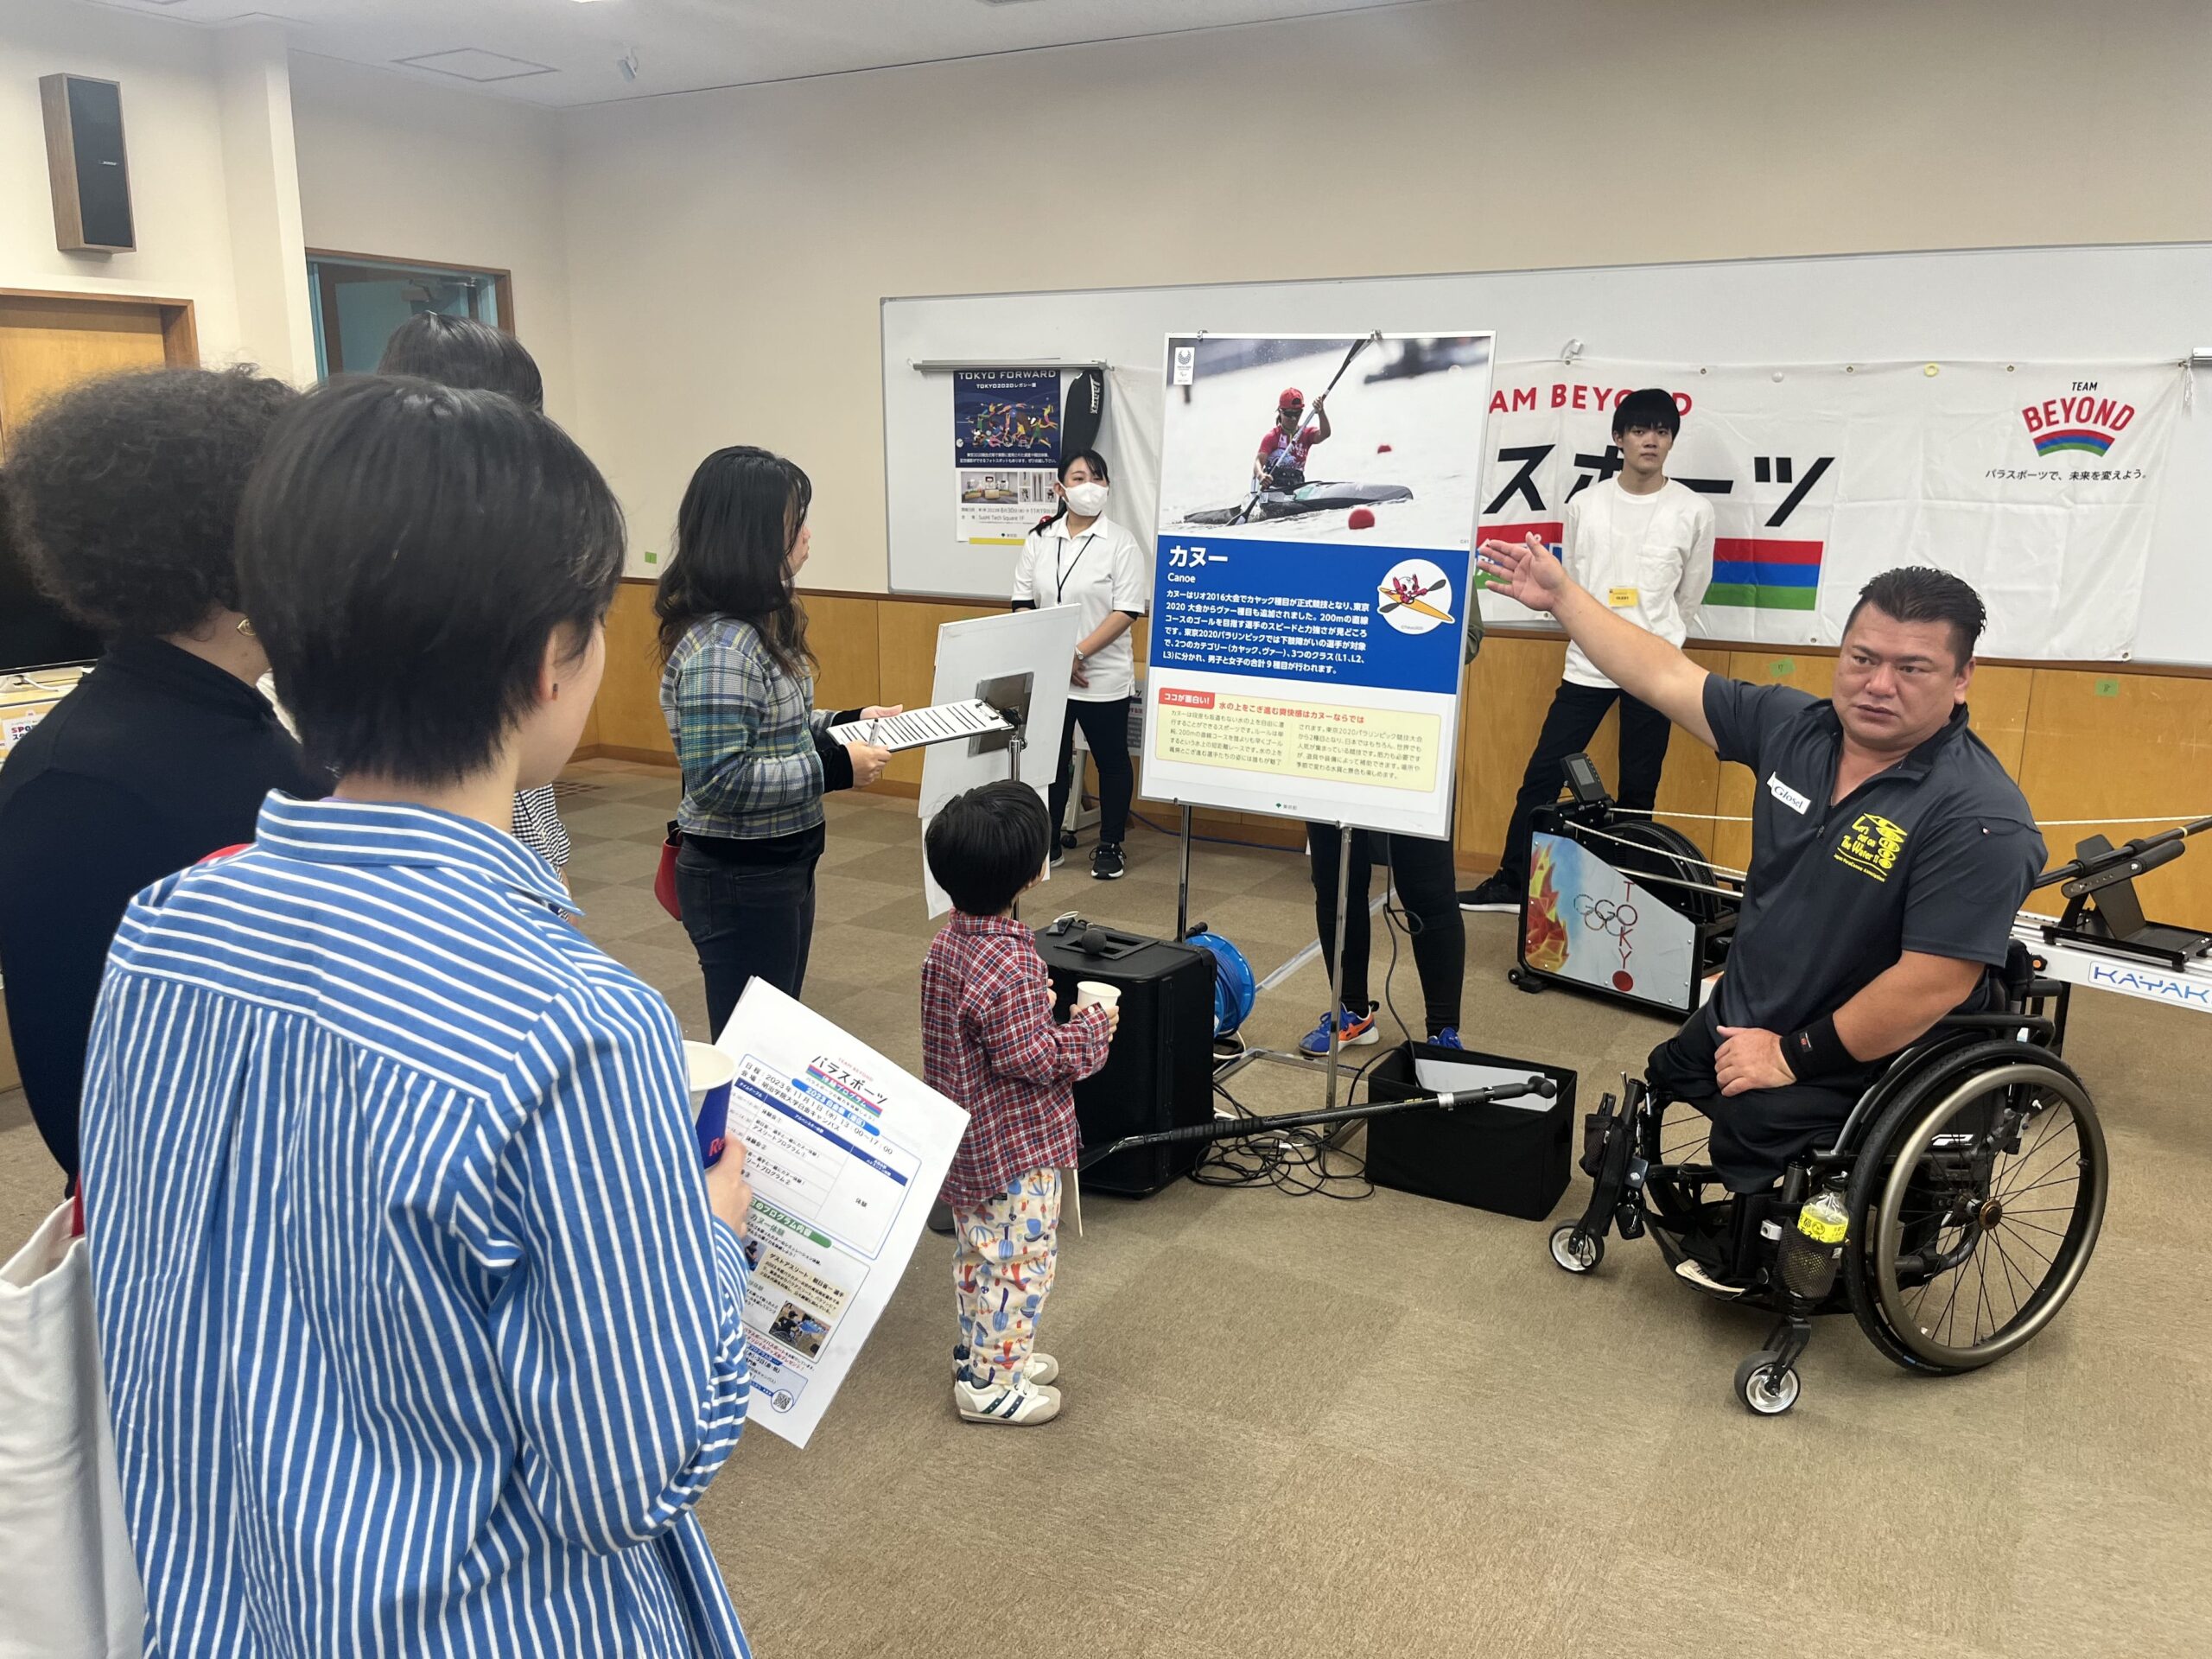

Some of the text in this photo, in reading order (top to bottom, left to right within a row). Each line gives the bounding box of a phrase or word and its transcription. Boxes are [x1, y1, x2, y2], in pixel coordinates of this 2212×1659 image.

[959, 370, 1056, 380] TOKYO FORWARD
[2071, 382, 2098, 391] TEAM
[2022, 396, 2135, 434] BEYOND
[1986, 469, 2147, 481] パラスポーツで、未来を変えよう。
[1169, 545, 1229, 568] カヌー
[1168, 573, 1196, 584] Canoe
[1165, 614, 1367, 638] コースのゴールを目指す選手のスピードと力強さが見どころ
[812, 1056, 888, 1105] パラスポーツ
